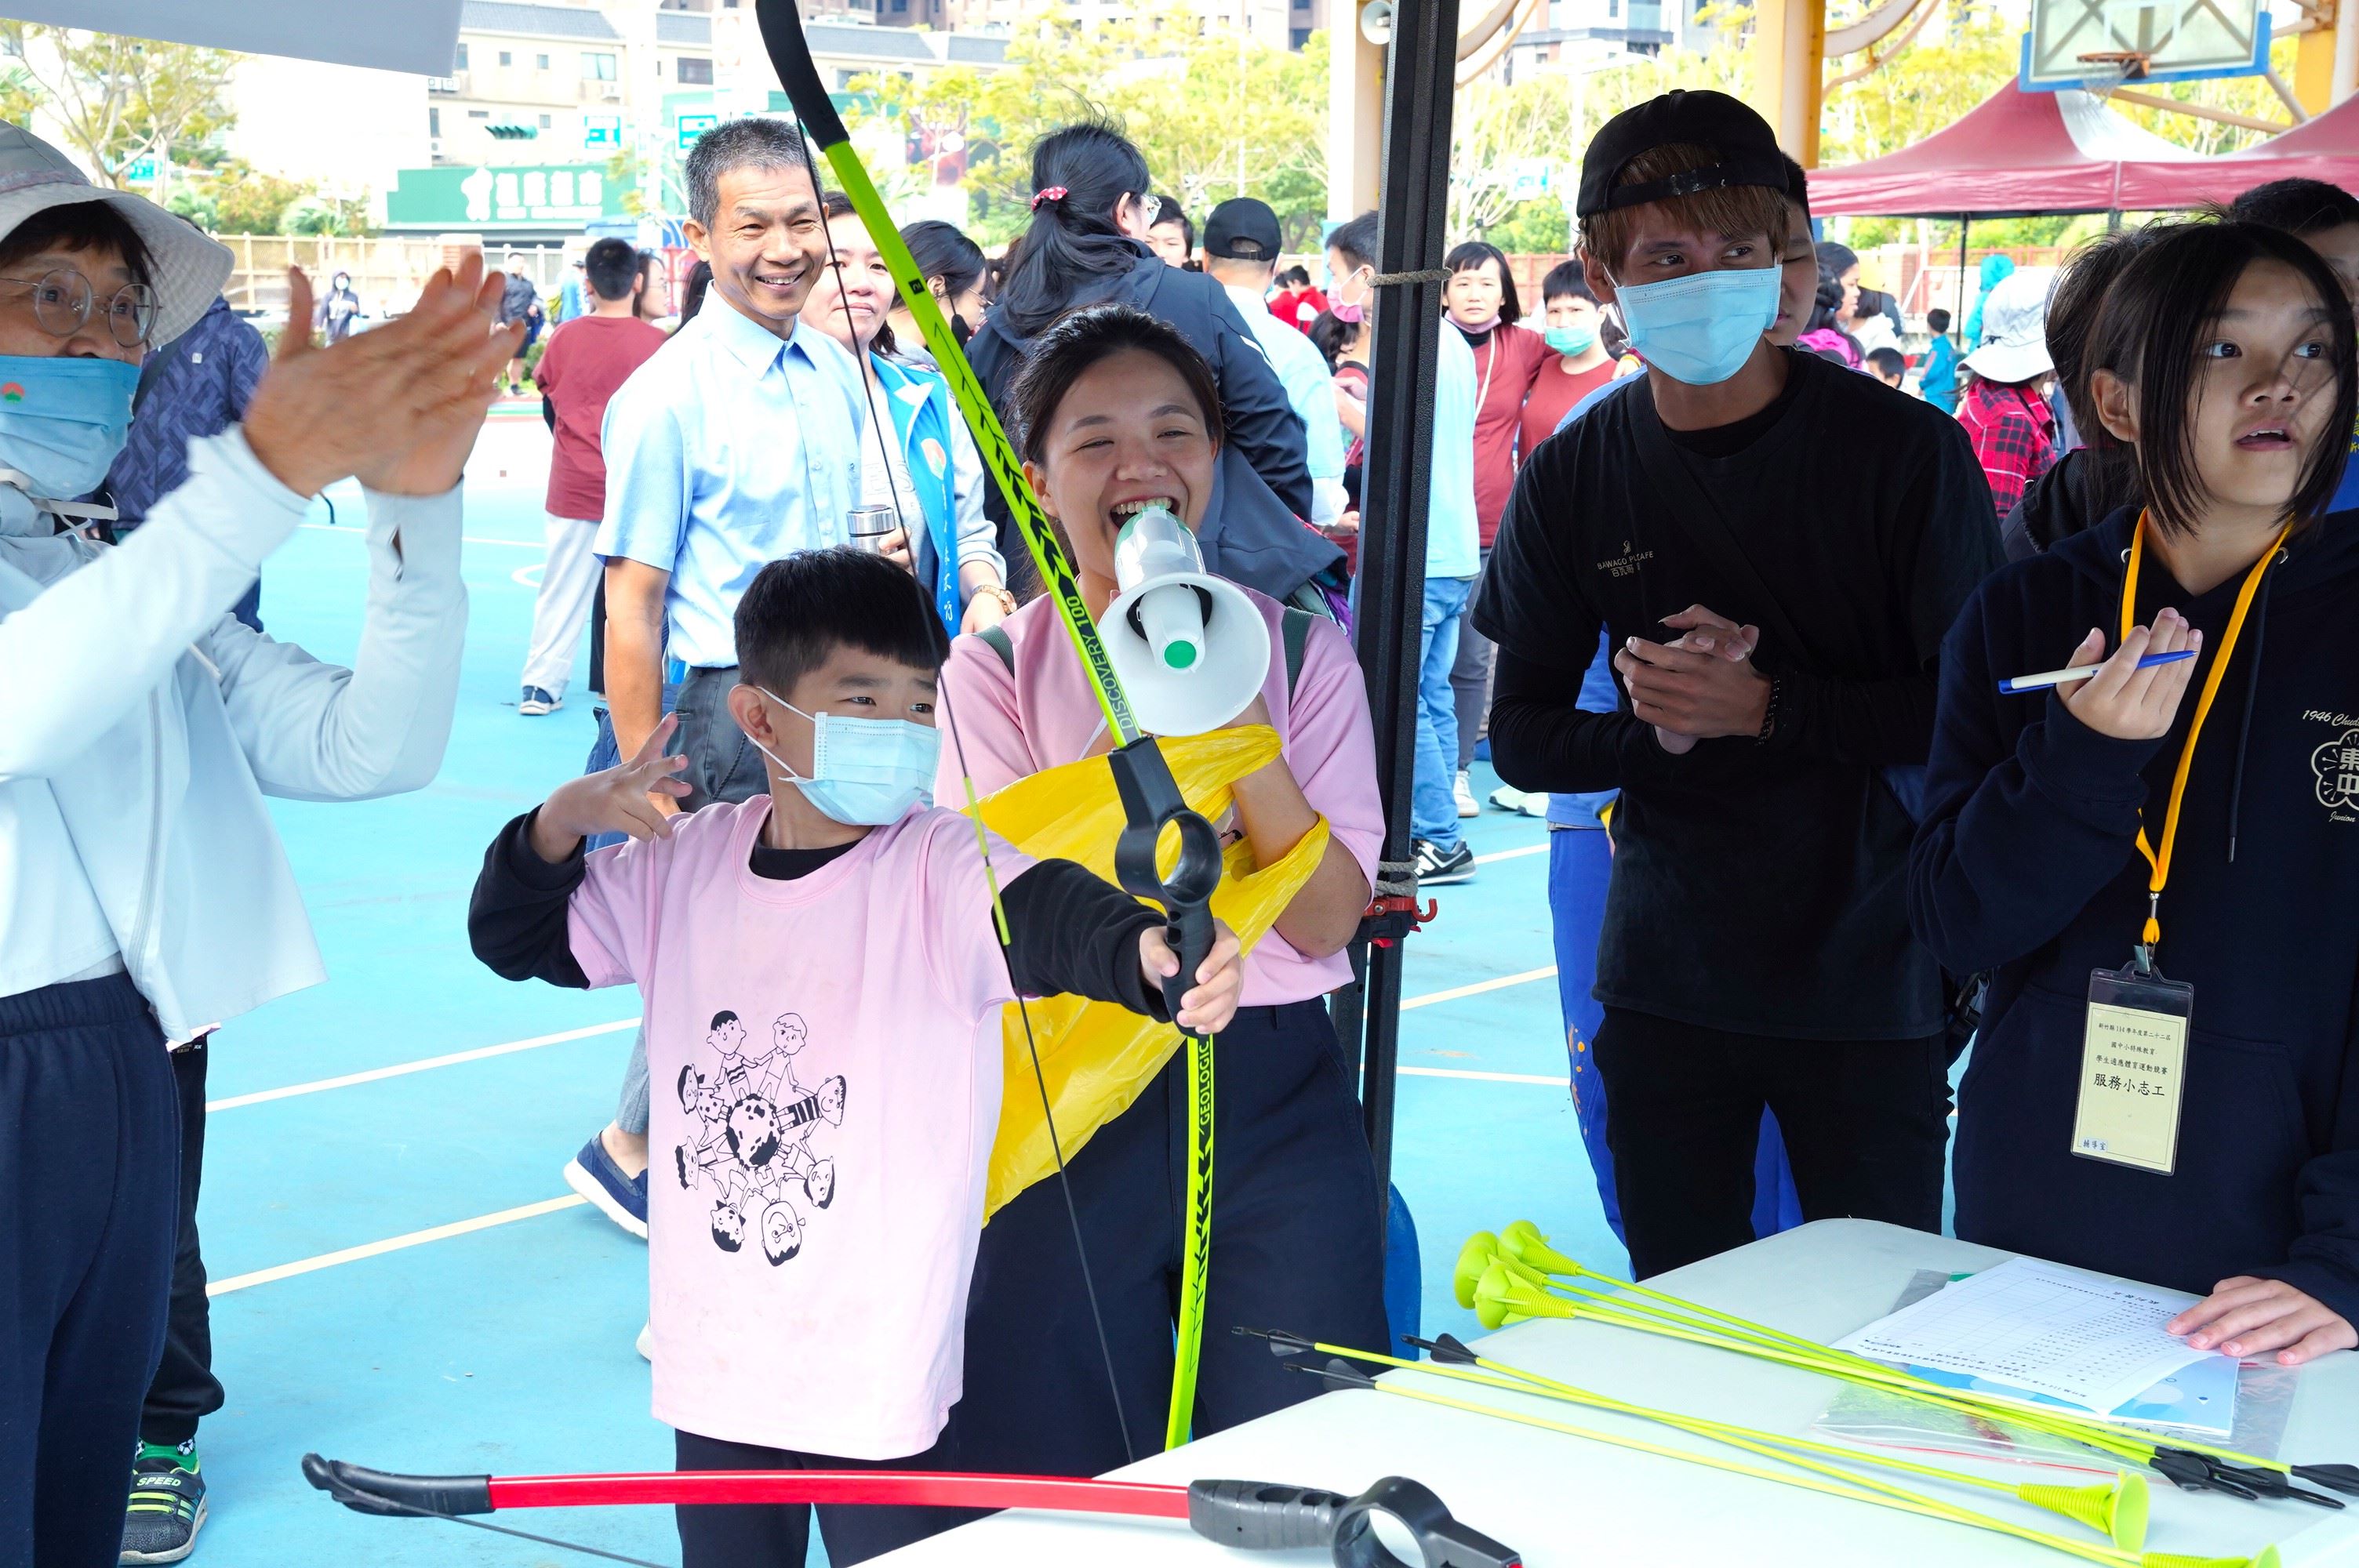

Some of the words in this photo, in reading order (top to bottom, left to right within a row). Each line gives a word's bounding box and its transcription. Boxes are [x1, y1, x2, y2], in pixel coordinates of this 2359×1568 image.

[1067, 595, 1089, 627] 100
[1082, 634, 1134, 730] DISCOVERY
[2303, 710, 2332, 722] 1946
[2332, 713, 2359, 726] Chud
[2111, 1041, 2156, 1055] 國中小特殊教育
[1199, 1040, 1210, 1126] GEOLOGIC
[2093, 1073, 2165, 1096] 服務小志工
[136, 1476, 181, 1486] SPEED
